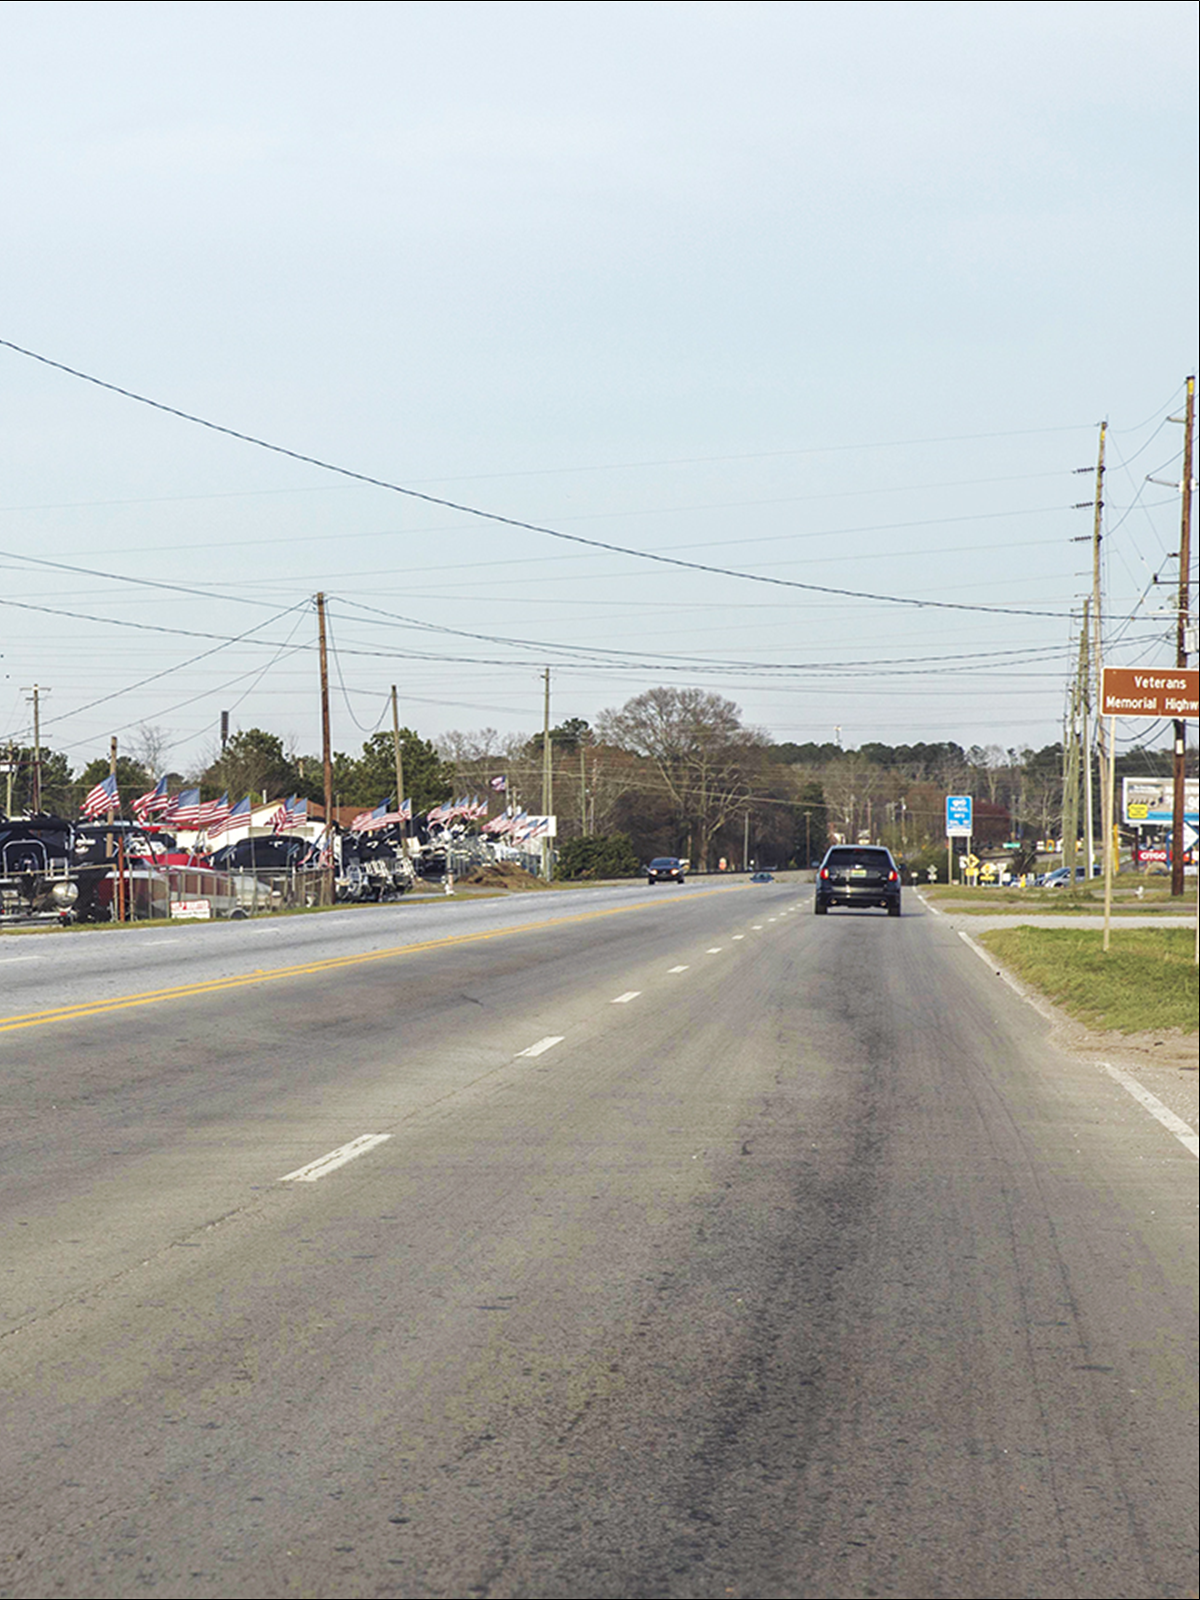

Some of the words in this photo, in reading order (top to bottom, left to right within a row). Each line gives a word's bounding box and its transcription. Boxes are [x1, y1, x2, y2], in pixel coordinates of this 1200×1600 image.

[1134, 676, 1187, 689] Veterans
[1106, 696, 1157, 709] Memorial
[1140, 852, 1167, 860] CITGO
